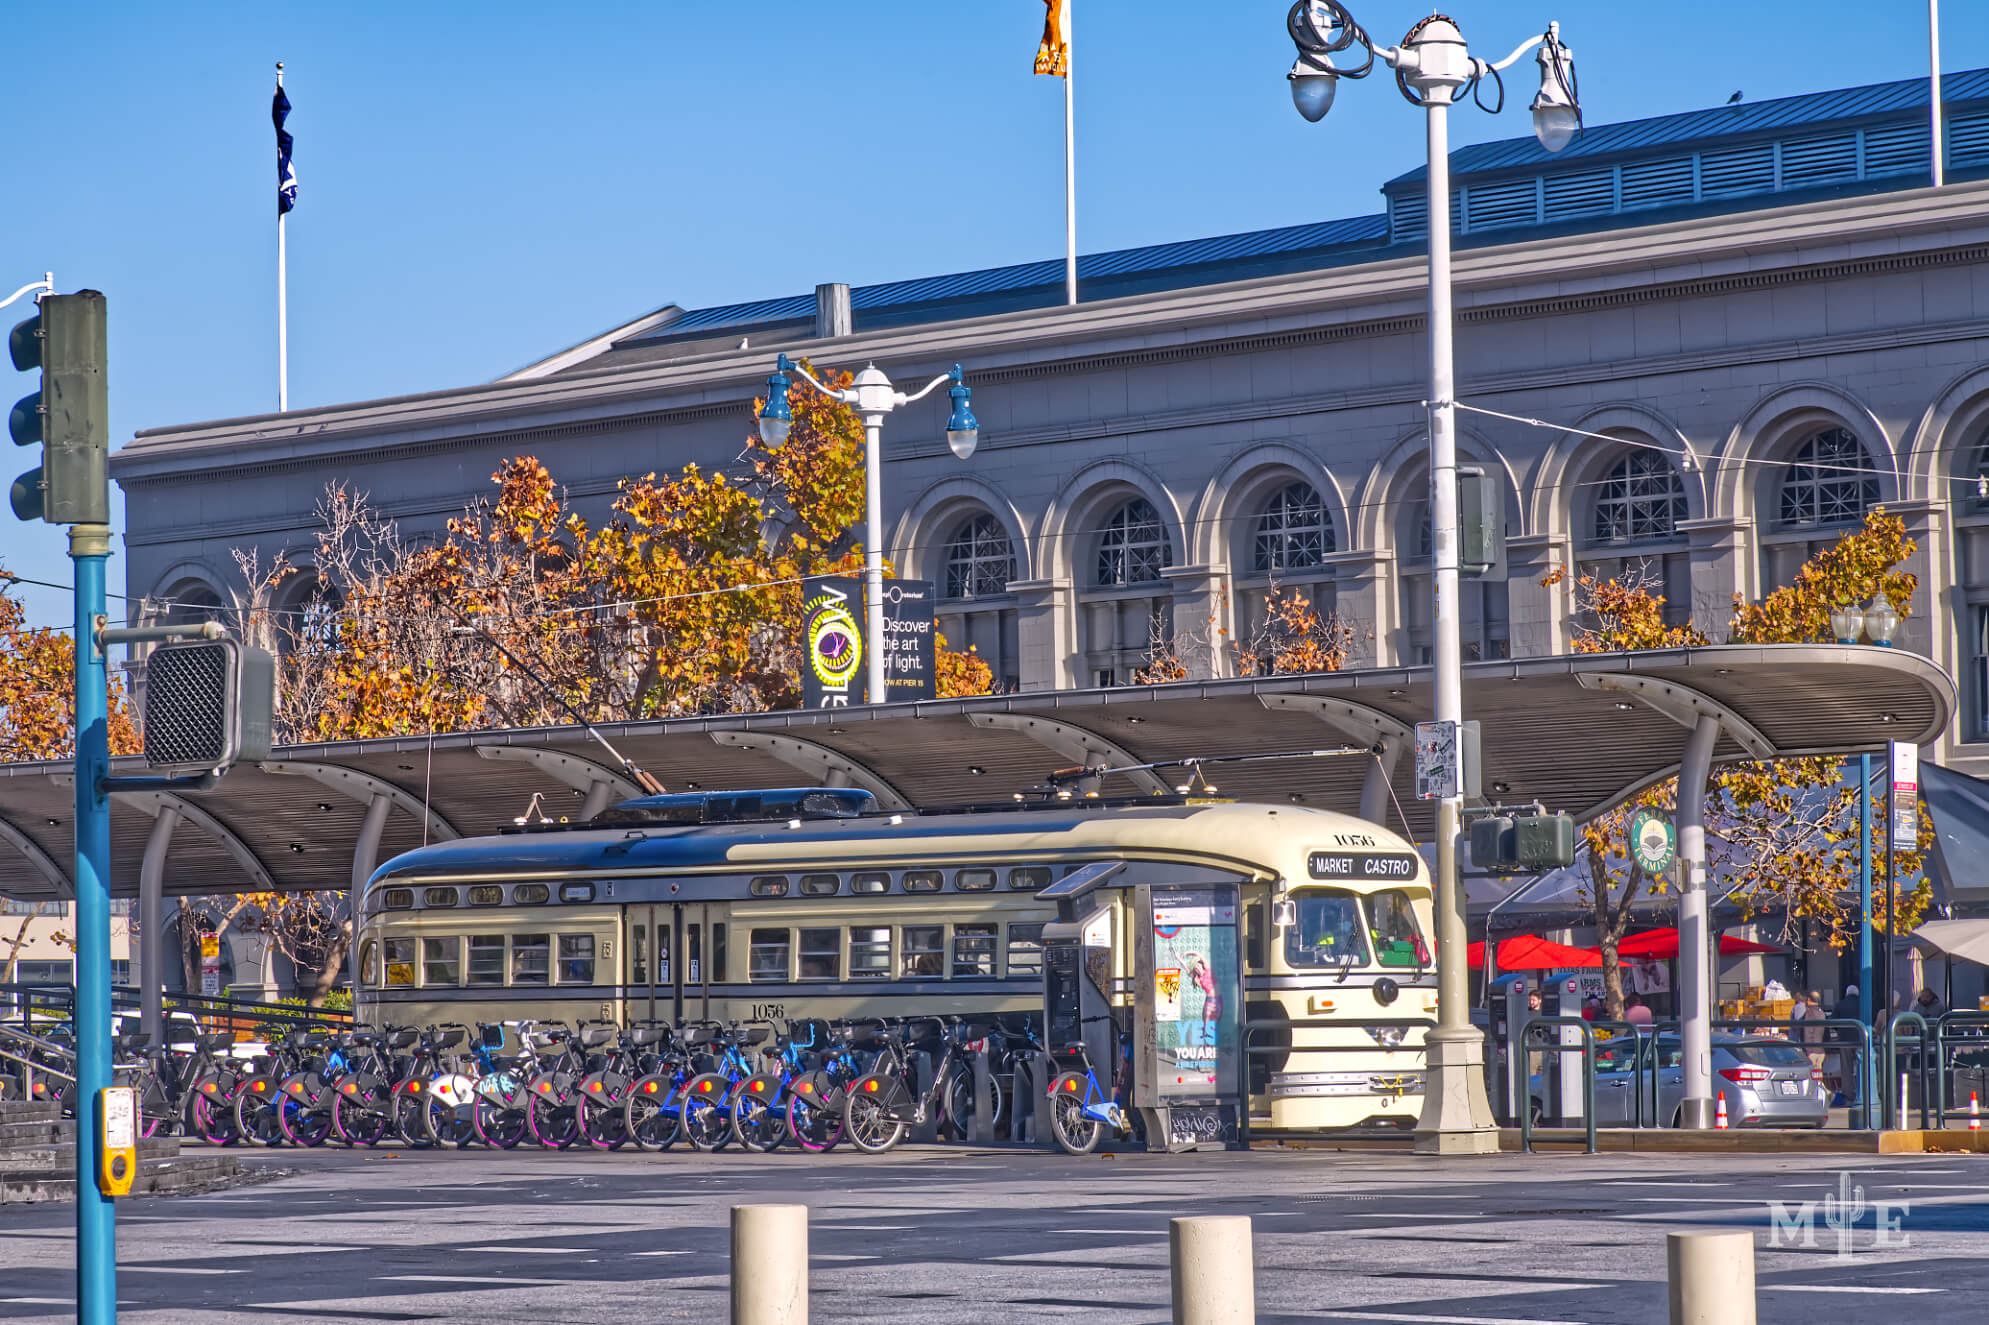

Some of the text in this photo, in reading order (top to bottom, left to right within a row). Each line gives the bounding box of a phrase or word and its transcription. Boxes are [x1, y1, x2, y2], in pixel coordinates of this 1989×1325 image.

[882, 617, 930, 632] Discover
[883, 634, 918, 650] the art
[883, 654, 923, 672] of light.
[1334, 835, 1375, 846] 1056
[1316, 857, 1410, 874] MARKET CASTRO
[1634, 845, 1674, 871] TERMINAL
[751, 1003, 784, 1019] 1056
[1176, 1020, 1218, 1046] YES
[1175, 1047, 1197, 1059] YOU
